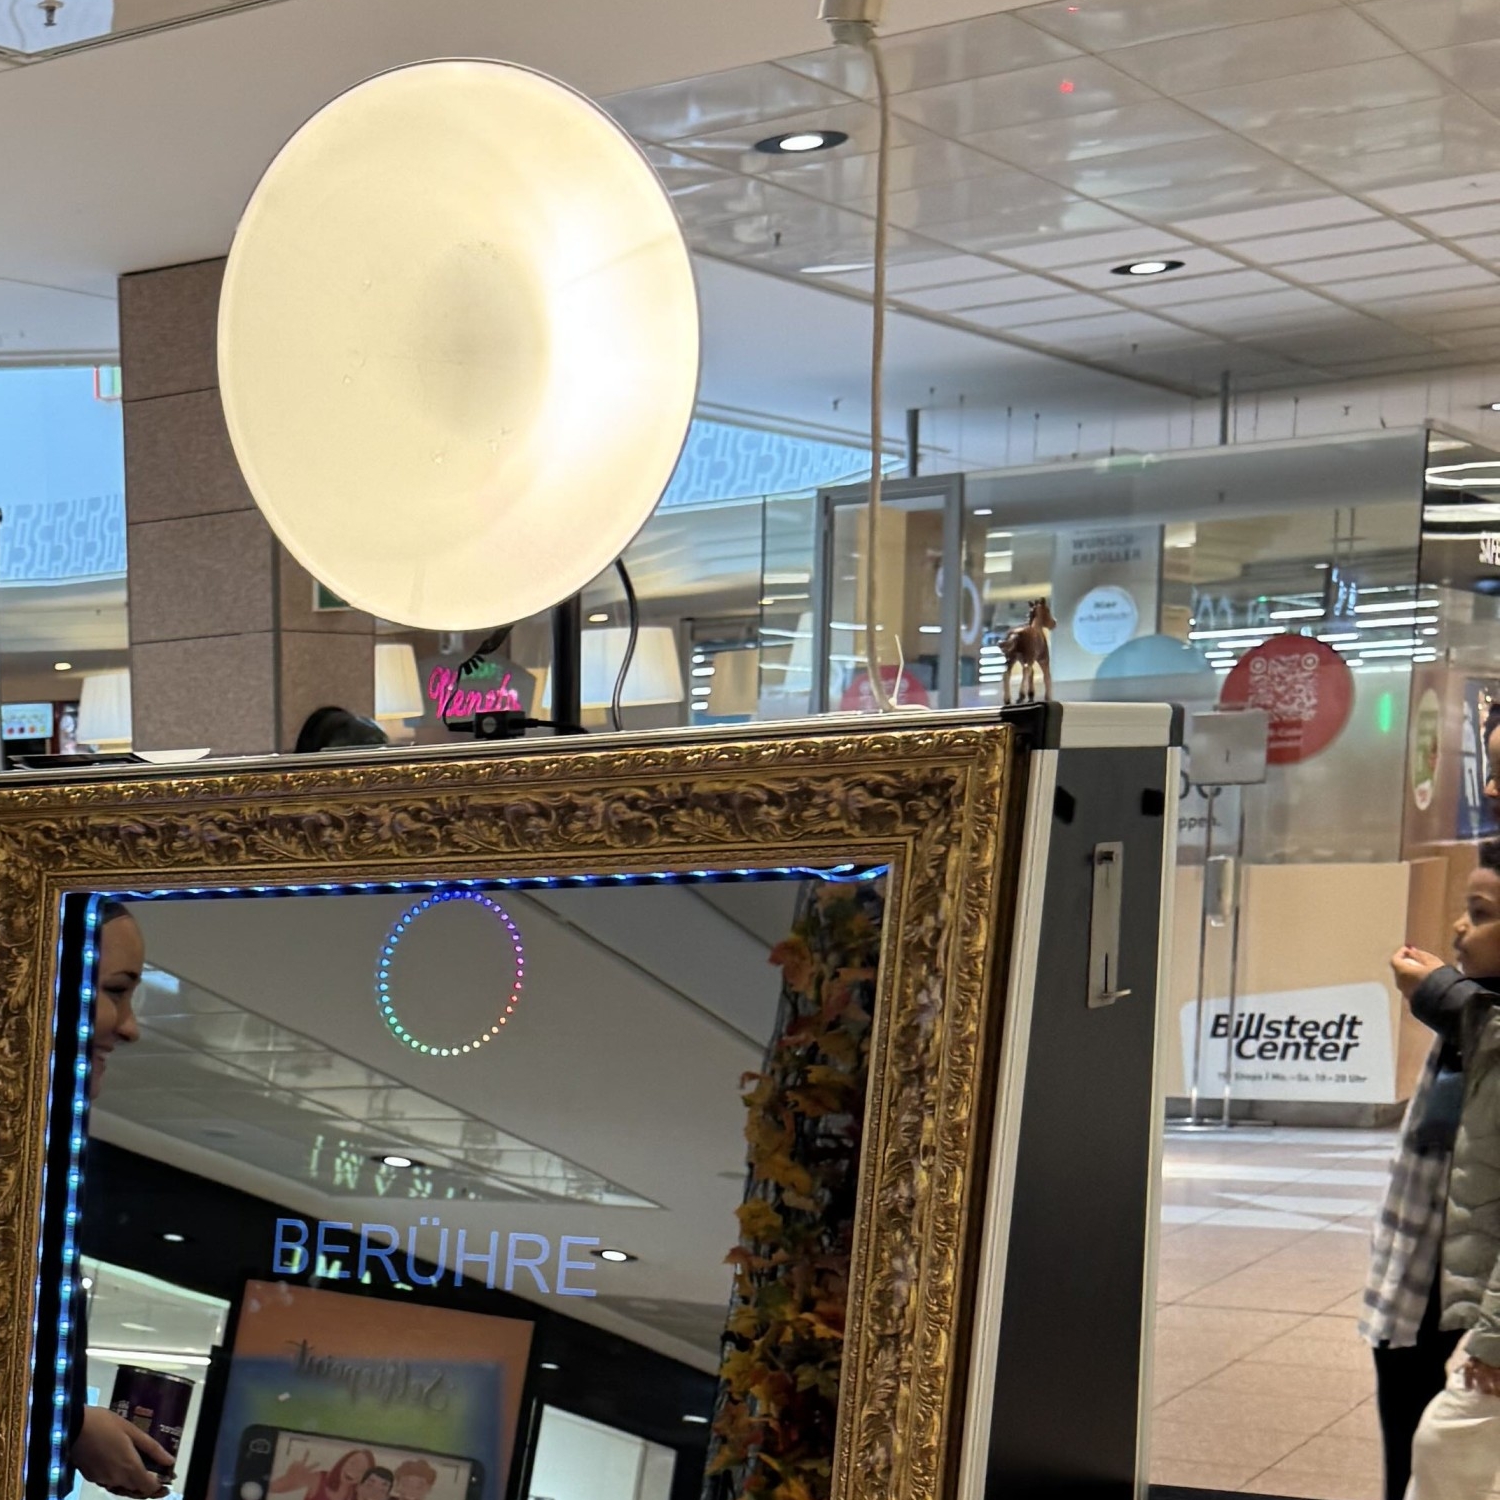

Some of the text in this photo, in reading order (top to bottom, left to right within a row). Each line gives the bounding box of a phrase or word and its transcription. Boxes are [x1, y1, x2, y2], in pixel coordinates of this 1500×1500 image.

[1210, 1013, 1363, 1040] Billstedt
[1235, 1036, 1359, 1062] Center
[273, 1216, 600, 1298] BERÜHRE
